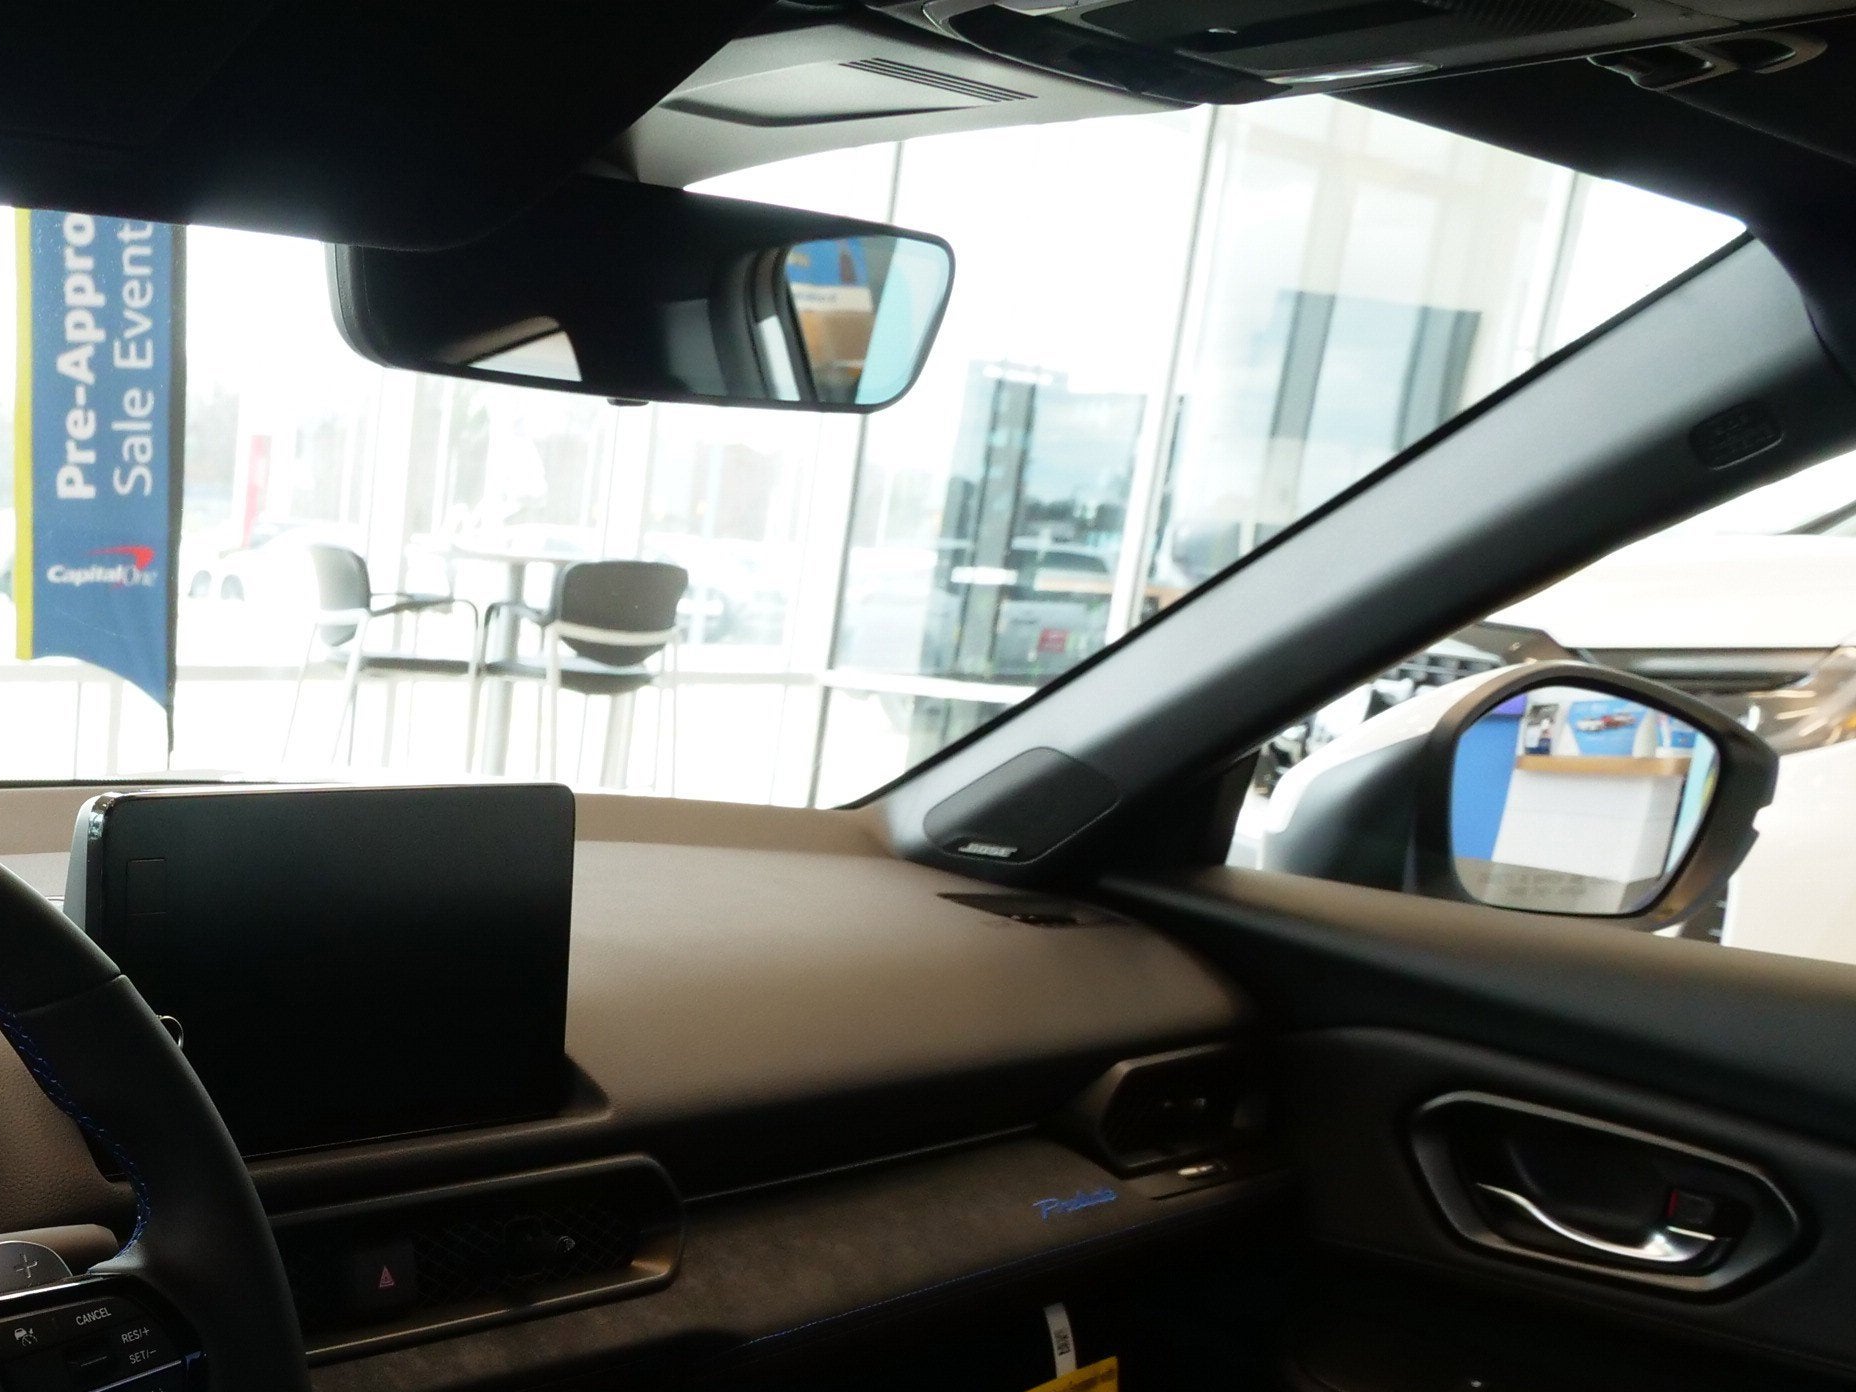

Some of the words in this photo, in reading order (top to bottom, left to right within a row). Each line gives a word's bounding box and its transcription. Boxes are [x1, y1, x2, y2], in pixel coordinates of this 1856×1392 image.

[56, 213, 106, 499] Pre-Appro
[113, 222, 154, 368] Event
[111, 388, 154, 496] Sale
[75, 1307, 112, 1326] CANCEL
